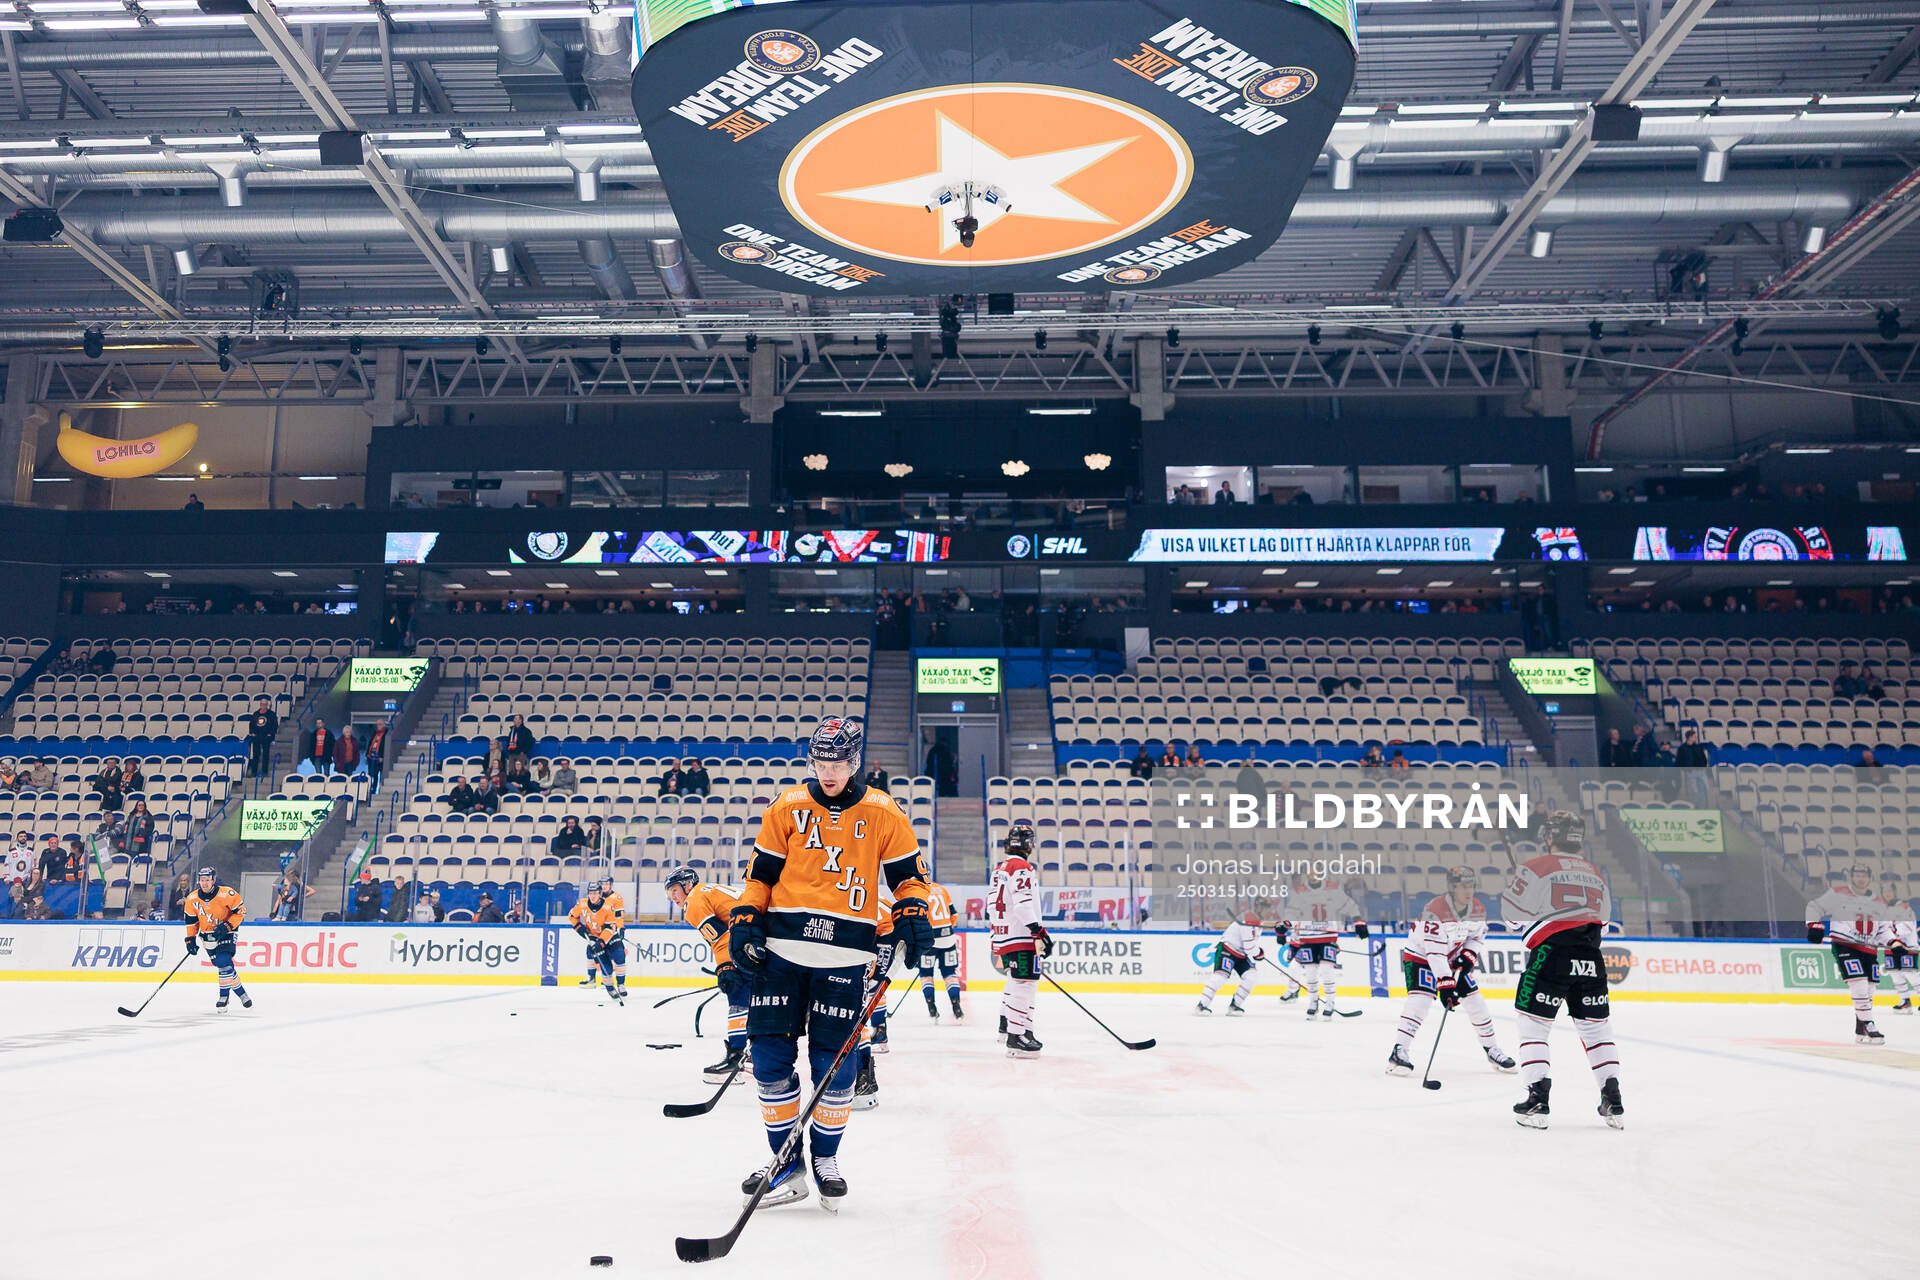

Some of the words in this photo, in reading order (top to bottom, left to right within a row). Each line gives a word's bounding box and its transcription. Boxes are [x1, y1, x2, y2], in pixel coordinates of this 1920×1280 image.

[812, 37, 884, 83] ONE
[1112, 42, 1183, 82] ONE
[1149, 17, 1274, 89] DREAM
[668, 58, 785, 125] DREAM
[742, 75, 832, 123] TEAM
[1154, 66, 1240, 113] TEAM
[707, 109, 770, 142] ONE
[1219, 101, 1288, 136] ONE
[722, 223, 785, 247] ONE
[776, 242, 850, 271] TEAM
[833, 264, 886, 282] ONE
[1056, 262, 1115, 283] ONE
[1104, 235, 1186, 266] TEAM
[1168, 218, 1228, 244] ONE
[1138, 227, 1252, 271] DREAM
[761, 255, 863, 291] DREAM
[96, 441, 156, 463] LOHILO
[1042, 537, 1088, 554] SHL
[1161, 537, 1194, 554] VISA
[1199, 537, 1246, 554] VILKET
[1250, 537, 1276, 553] LAG
[1281, 536, 1313, 553] DITT
[1317, 534, 1371, 553] HJÄRTA
[1376, 536, 1440, 552] KLAPPAR
[1444, 535, 1471, 552] FÖR
[384, 667, 403, 675] TAXI
[952, 669, 972, 677] TAXI
[820, 751, 838, 759] OBOS
[246, 808, 278, 820] VÄXJÖ
[281, 811, 302, 820] TAXI
[253, 822, 287, 831] 0470-135
[288, 822, 298, 831] 00
[854, 820, 866, 839] C
[1663, 821, 1688, 831] TAXI
[1016, 877, 1032, 890] 24
[803, 926, 835, 942] SEATING
[71, 945, 163, 968] KPMG
[389, 937, 520, 968] Hybridge
[546, 930, 556, 972] CCM
[1051, 940, 1143, 957] YDTRADE
[1041, 961, 1113, 975] RUCKAR
[1120, 962, 1143, 975] AB
[1646, 957, 1762, 976] GEHAB.com
[1797, 966, 1819, 979] ON
[828, 975, 852, 985] CCM
